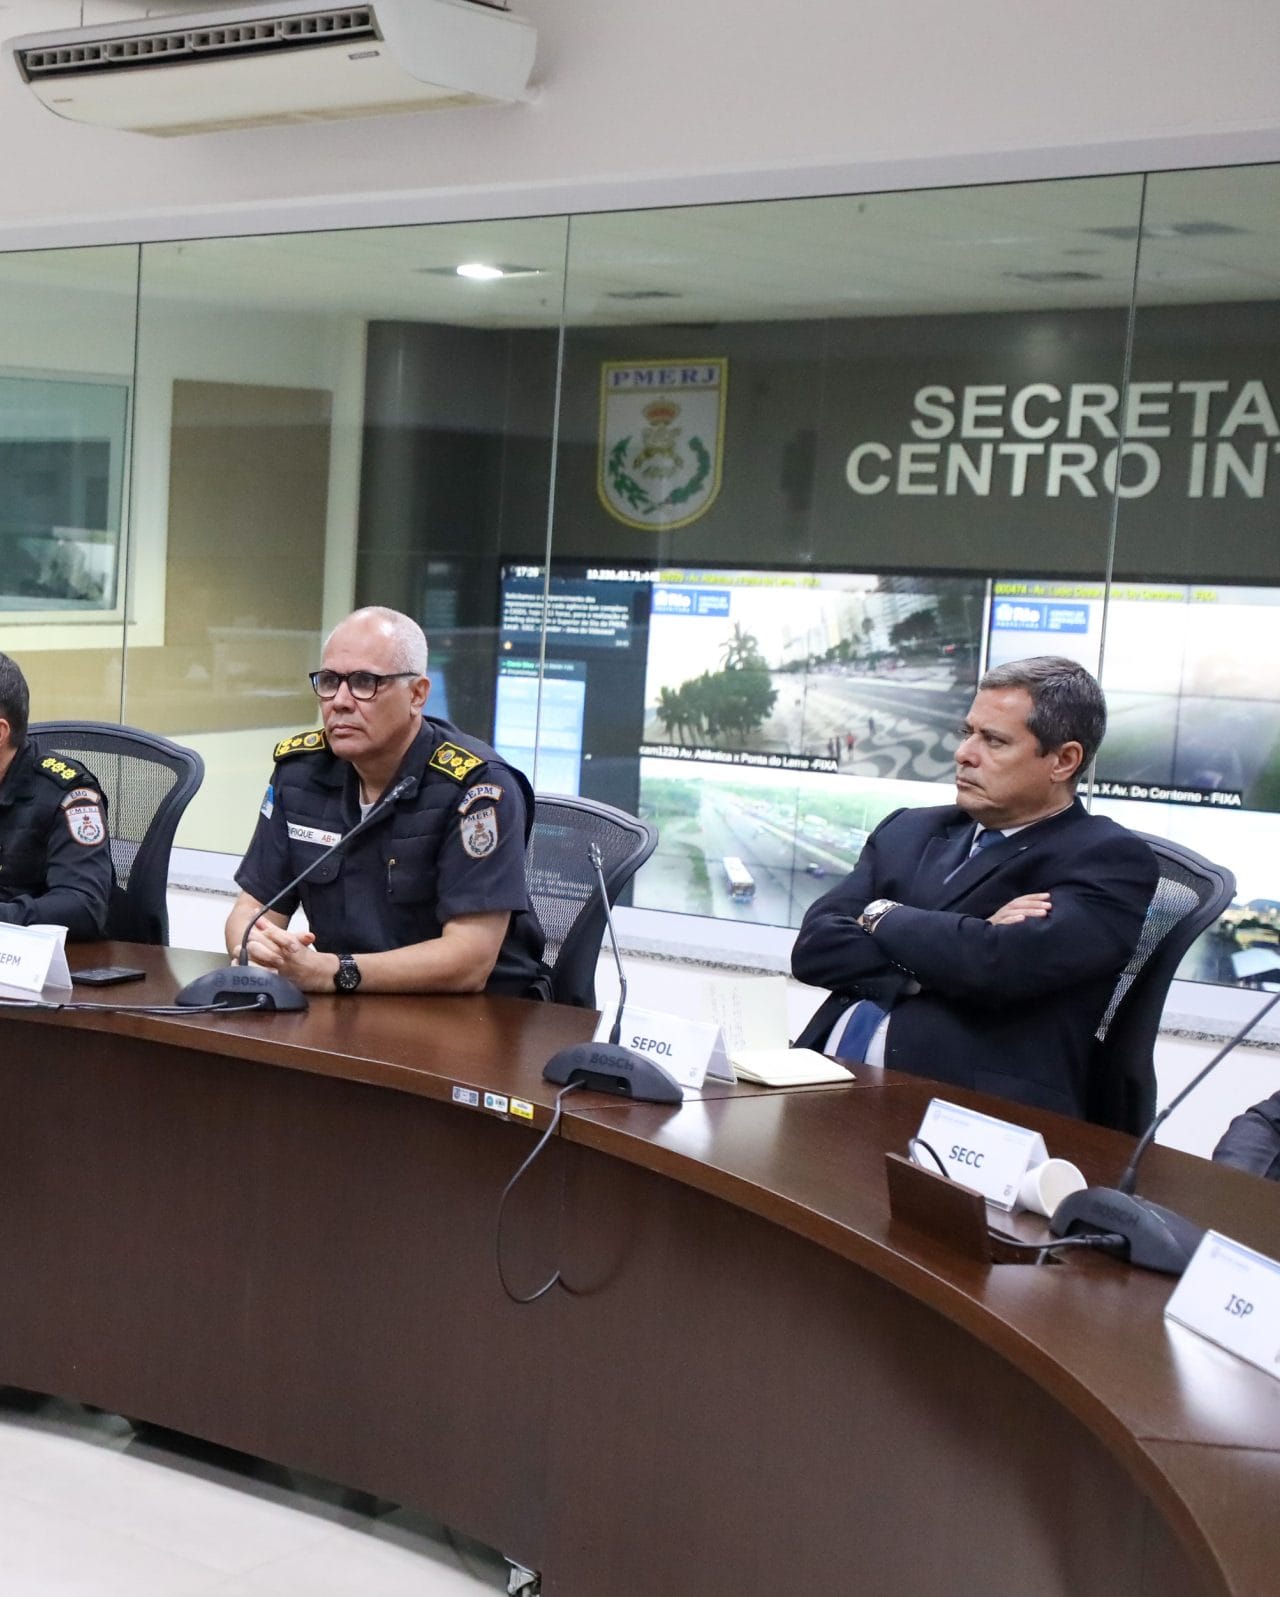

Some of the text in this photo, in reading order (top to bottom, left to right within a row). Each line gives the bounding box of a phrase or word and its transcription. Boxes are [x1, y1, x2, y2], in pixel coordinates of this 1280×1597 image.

[613, 368, 716, 386] PMERJ
[910, 380, 1280, 439] SECRETA
[845, 441, 1280, 499] CENTRO IN
[463, 786, 494, 804] SEPM
[1211, 791, 1242, 806] FIXA
[232, 975, 274, 987] BOSCH
[630, 1036, 673, 1057] SEPOL
[589, 1052, 635, 1071] BOSCH
[948, 1145, 985, 1169] SECC
[1224, 1293, 1254, 1318] ISP
